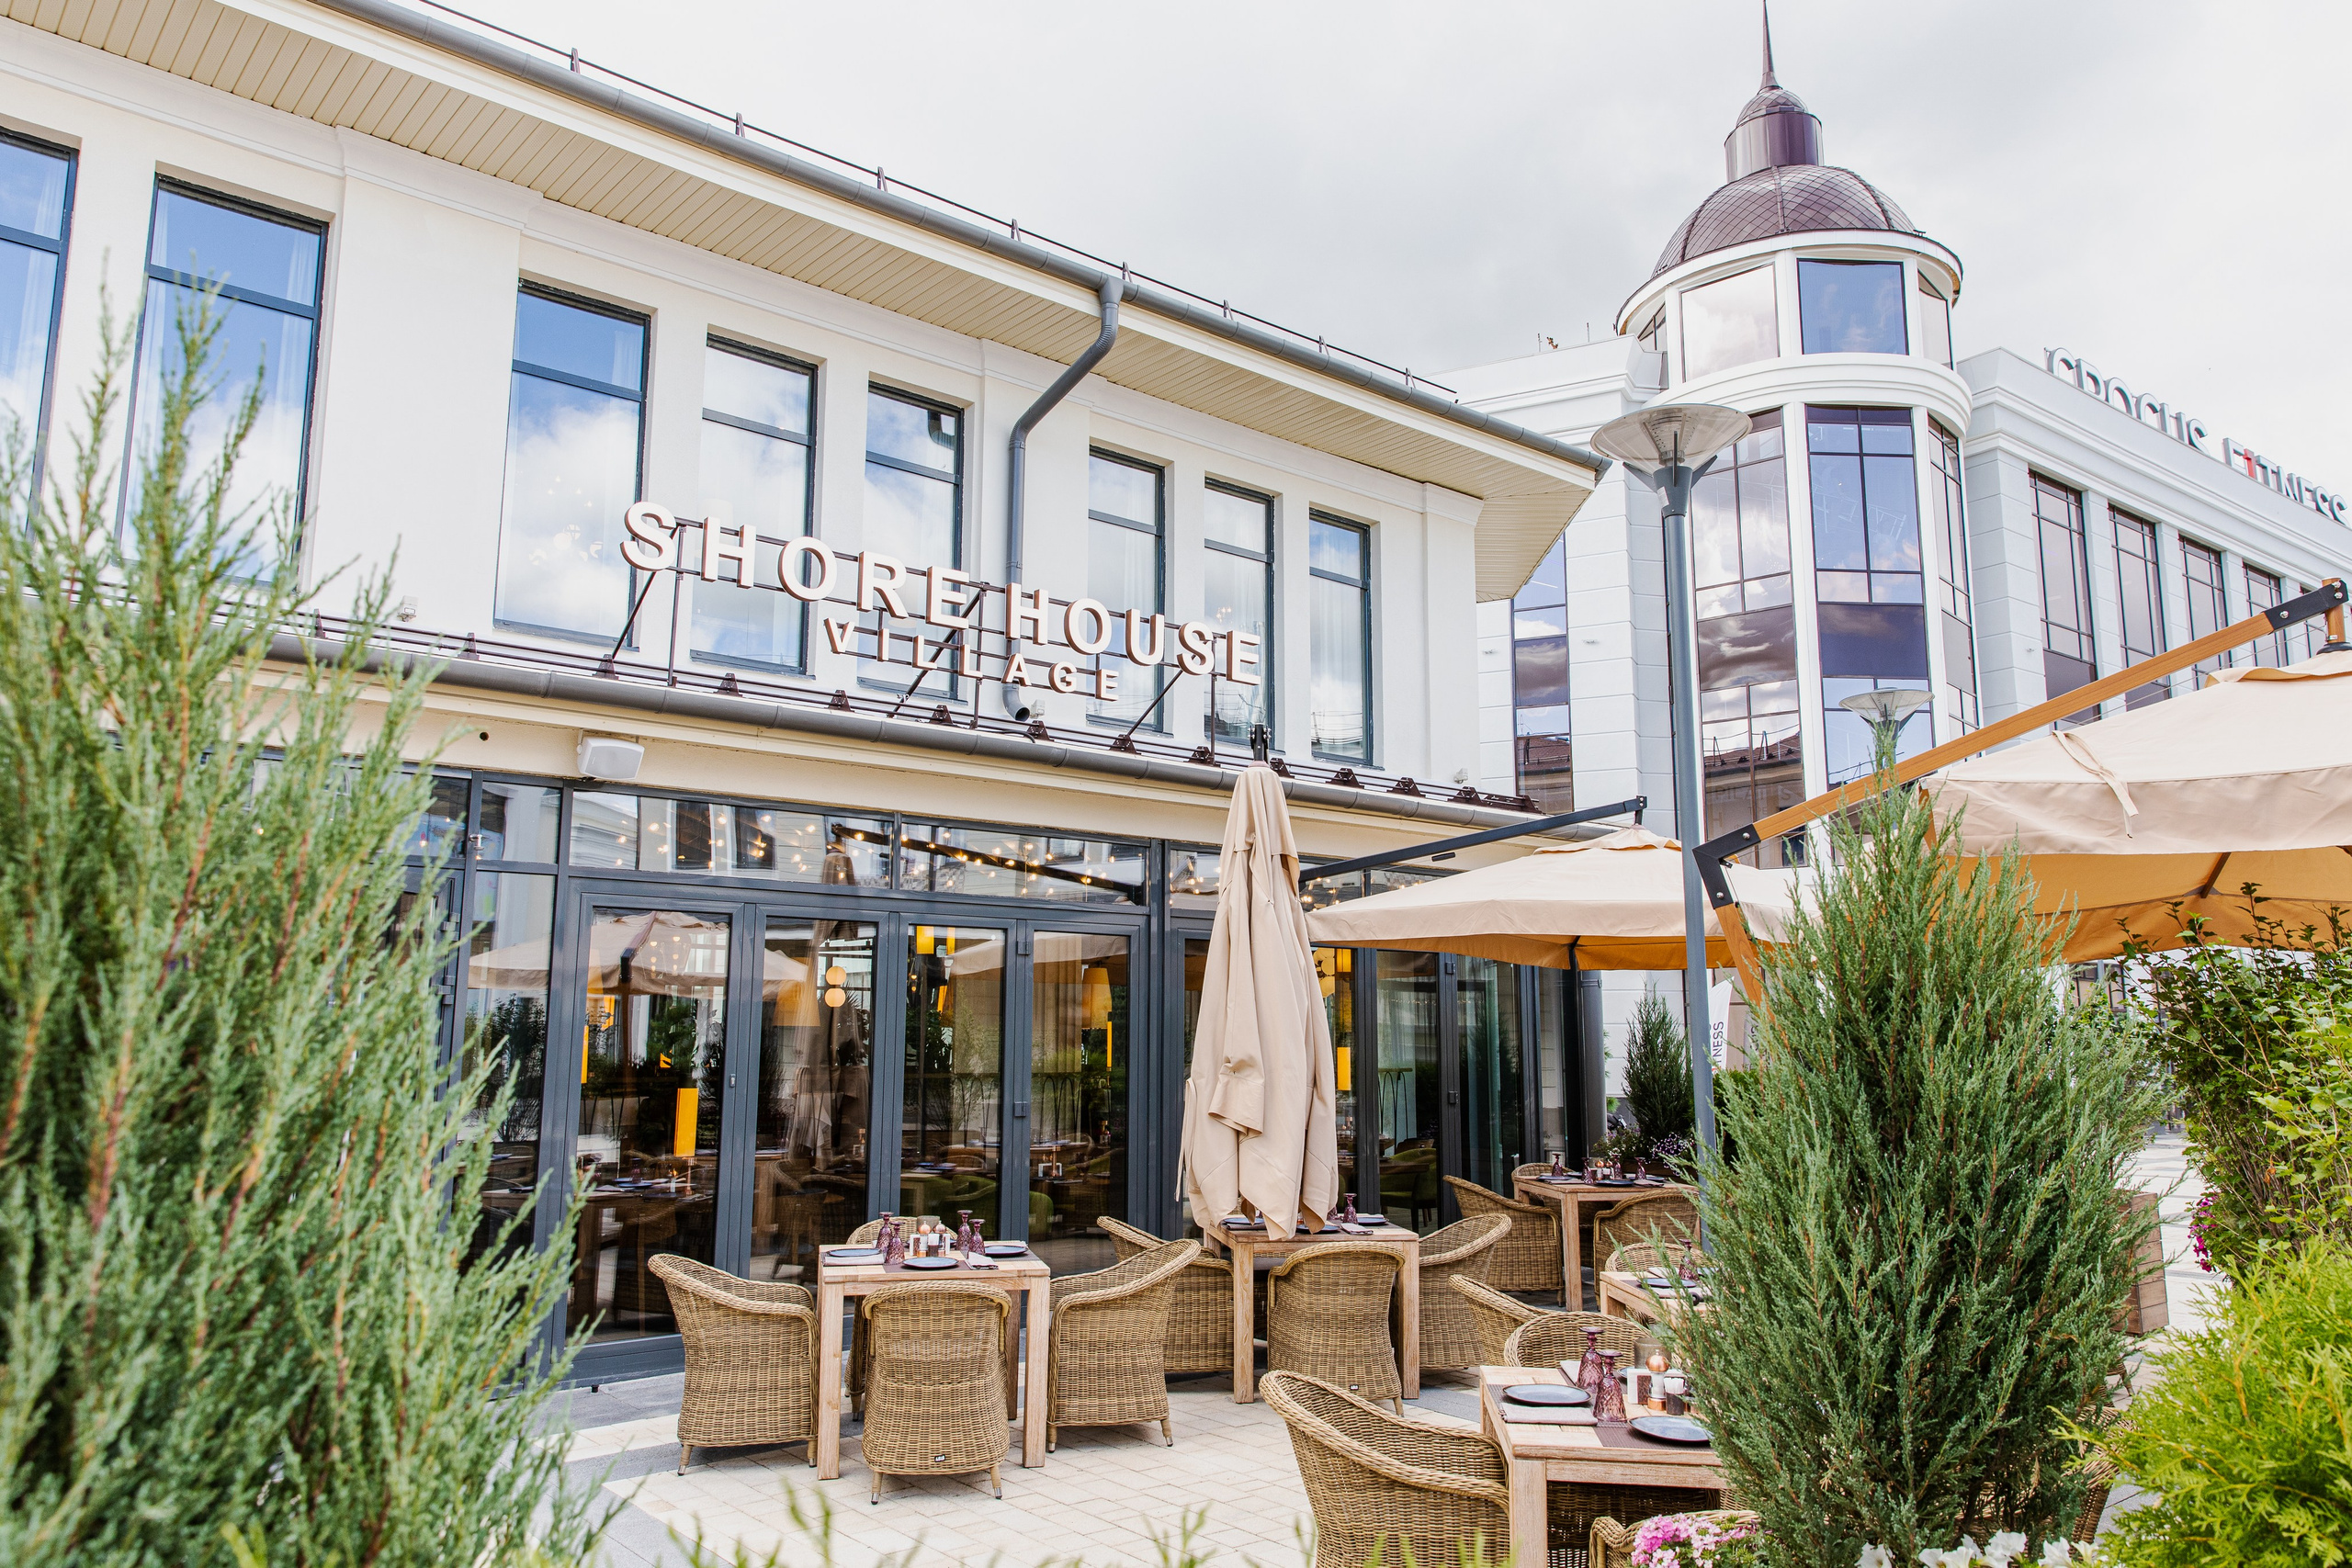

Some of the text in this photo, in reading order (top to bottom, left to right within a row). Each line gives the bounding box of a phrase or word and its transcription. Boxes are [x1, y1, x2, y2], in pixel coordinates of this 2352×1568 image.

[2222, 437, 2349, 525] FITNESS
[621, 502, 1261, 685] SHORE HOUSE
[824, 617, 1119, 701] VILLAGE
